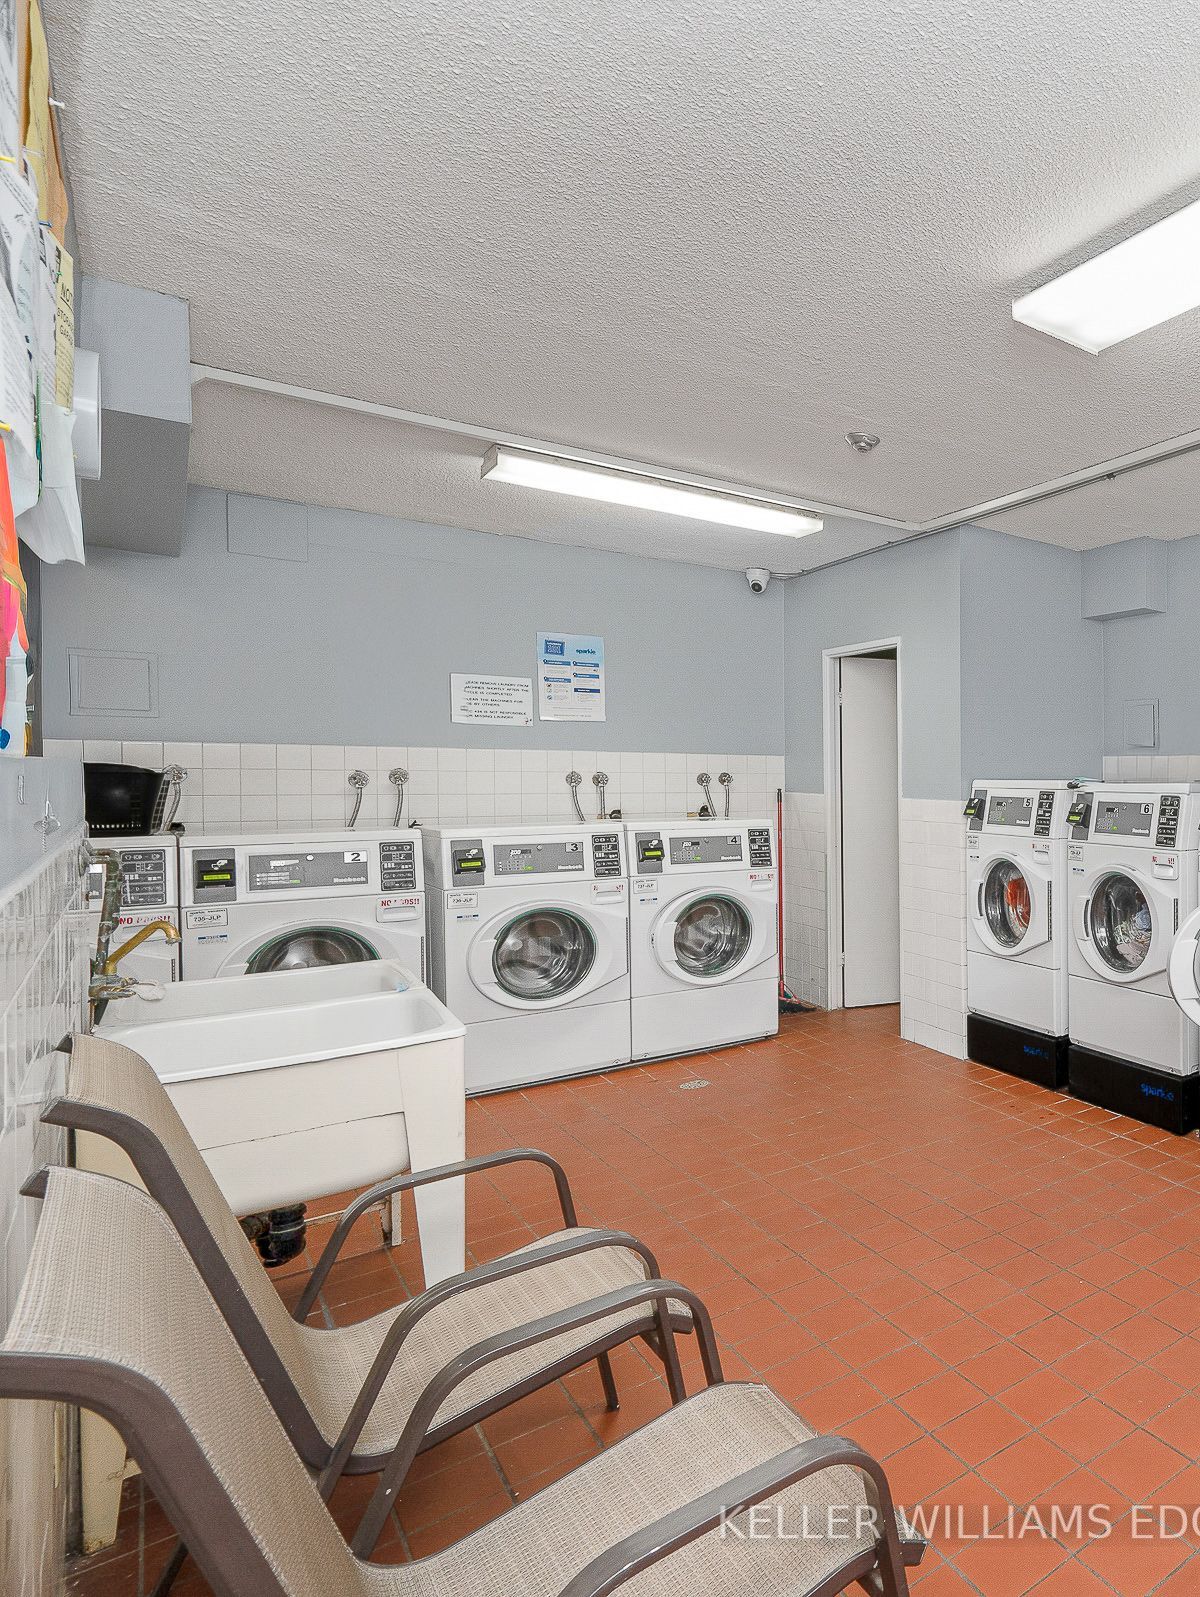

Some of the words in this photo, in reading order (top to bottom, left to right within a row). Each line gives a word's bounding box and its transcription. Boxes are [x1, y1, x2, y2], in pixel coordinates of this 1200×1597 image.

[1025, 798, 1030, 806] 5
[1144, 804, 1150, 814] 6
[730, 836, 738, 844] 4
[570, 843, 579, 851] 3
[351, 852, 361, 862] 2
